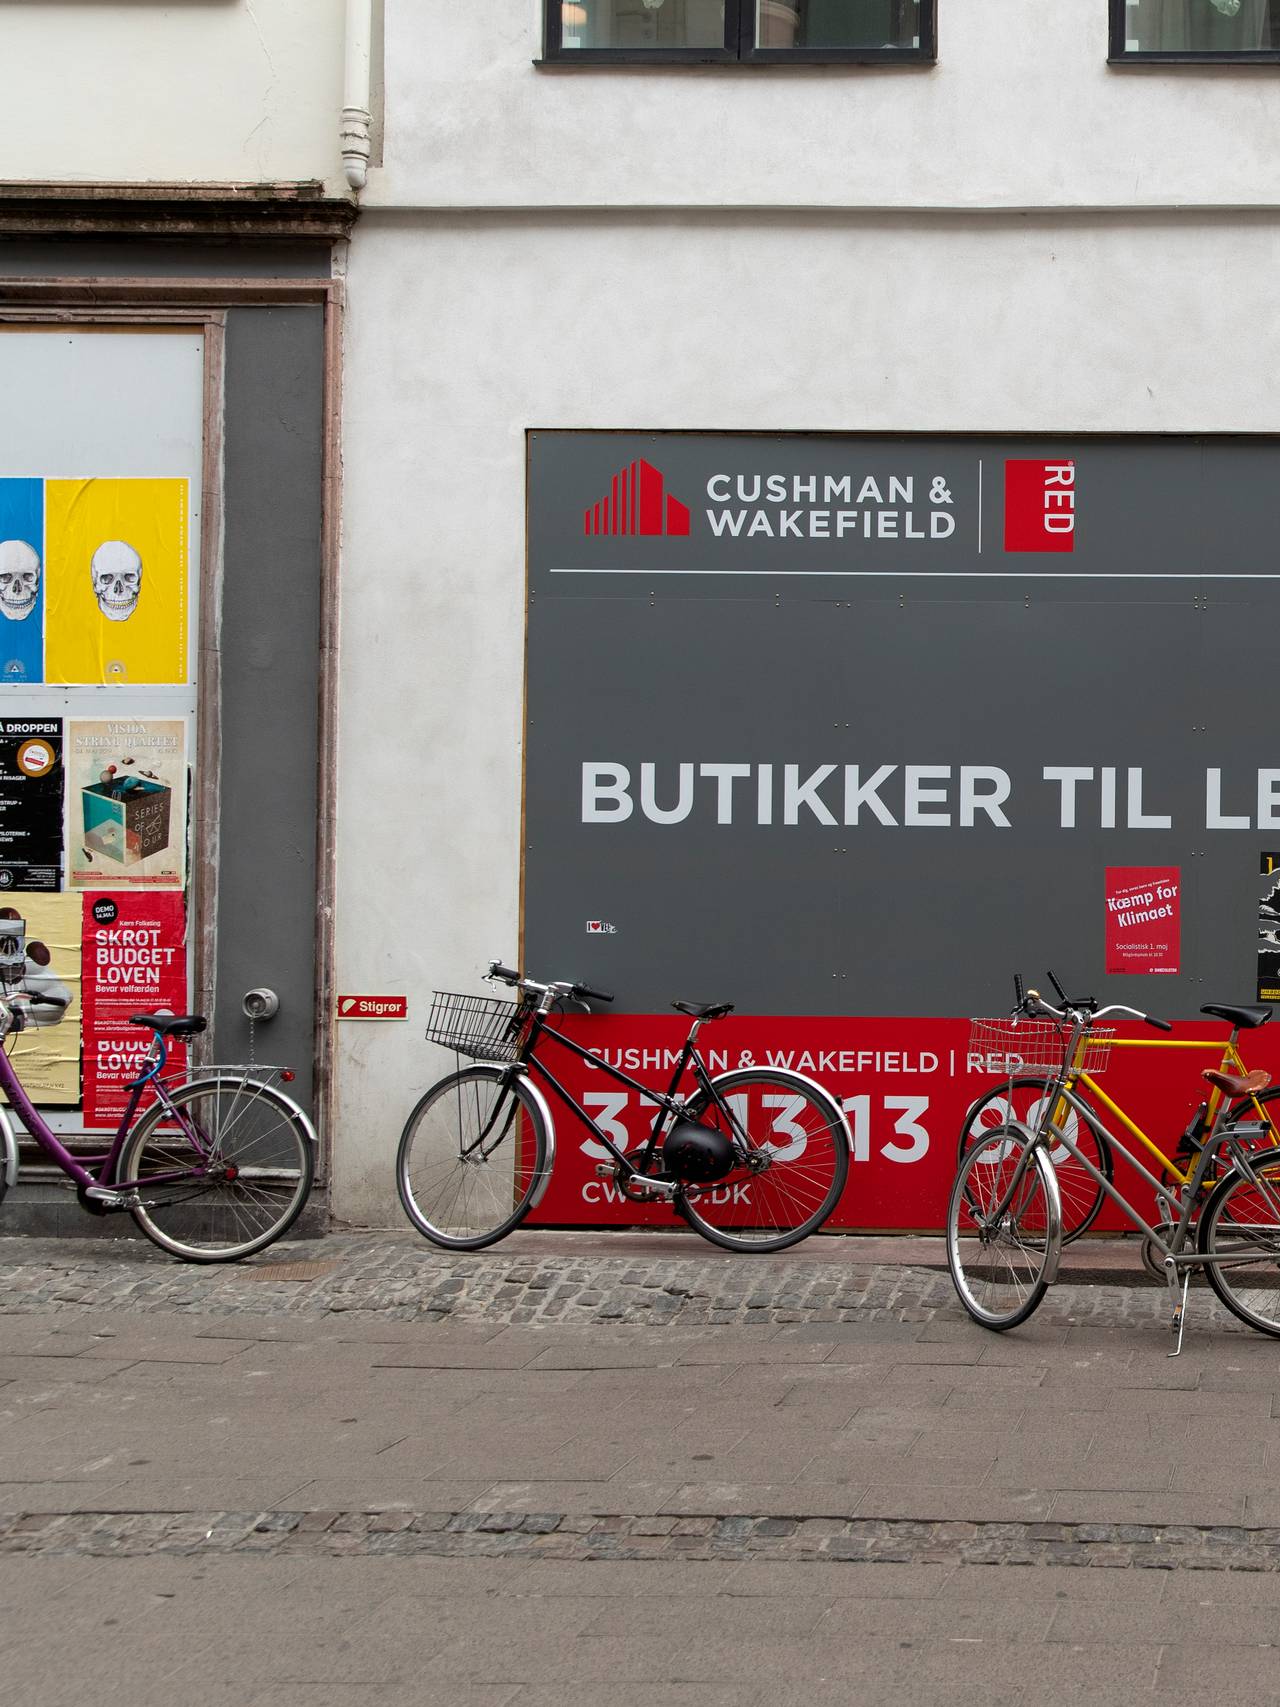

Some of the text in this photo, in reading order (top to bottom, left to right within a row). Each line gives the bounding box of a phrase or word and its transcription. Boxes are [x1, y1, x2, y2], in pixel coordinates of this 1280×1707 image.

[707, 474, 954, 504] CUSHMAN &
[1044, 465, 1075, 534] RED
[706, 509, 956, 539] WAKEFIELD
[6, 723, 58, 733] DROPPEN
[581, 761, 1011, 827] BUTIKKER
[1043, 766, 1172, 829] TIL
[135, 802, 164, 820] SERIES
[1107, 886, 1178, 912] Kæmp for
[95, 905, 115, 914] DEMO
[1117, 904, 1174, 928] Klimaet
[95, 929, 161, 946] SKROT
[97, 948, 176, 965] BUDGET
[97, 967, 160, 984] LOVEN
[359, 1001, 402, 1015] Stigrør
[97, 1054, 160, 1071] LOVE
[738, 1050, 756, 1070] &
[766, 1050, 939, 1073] WAKEFIELD
[967, 1052, 1024, 1074] RED
[96, 1071, 119, 1080] Bevar
[841, 1094, 930, 1163] 13
